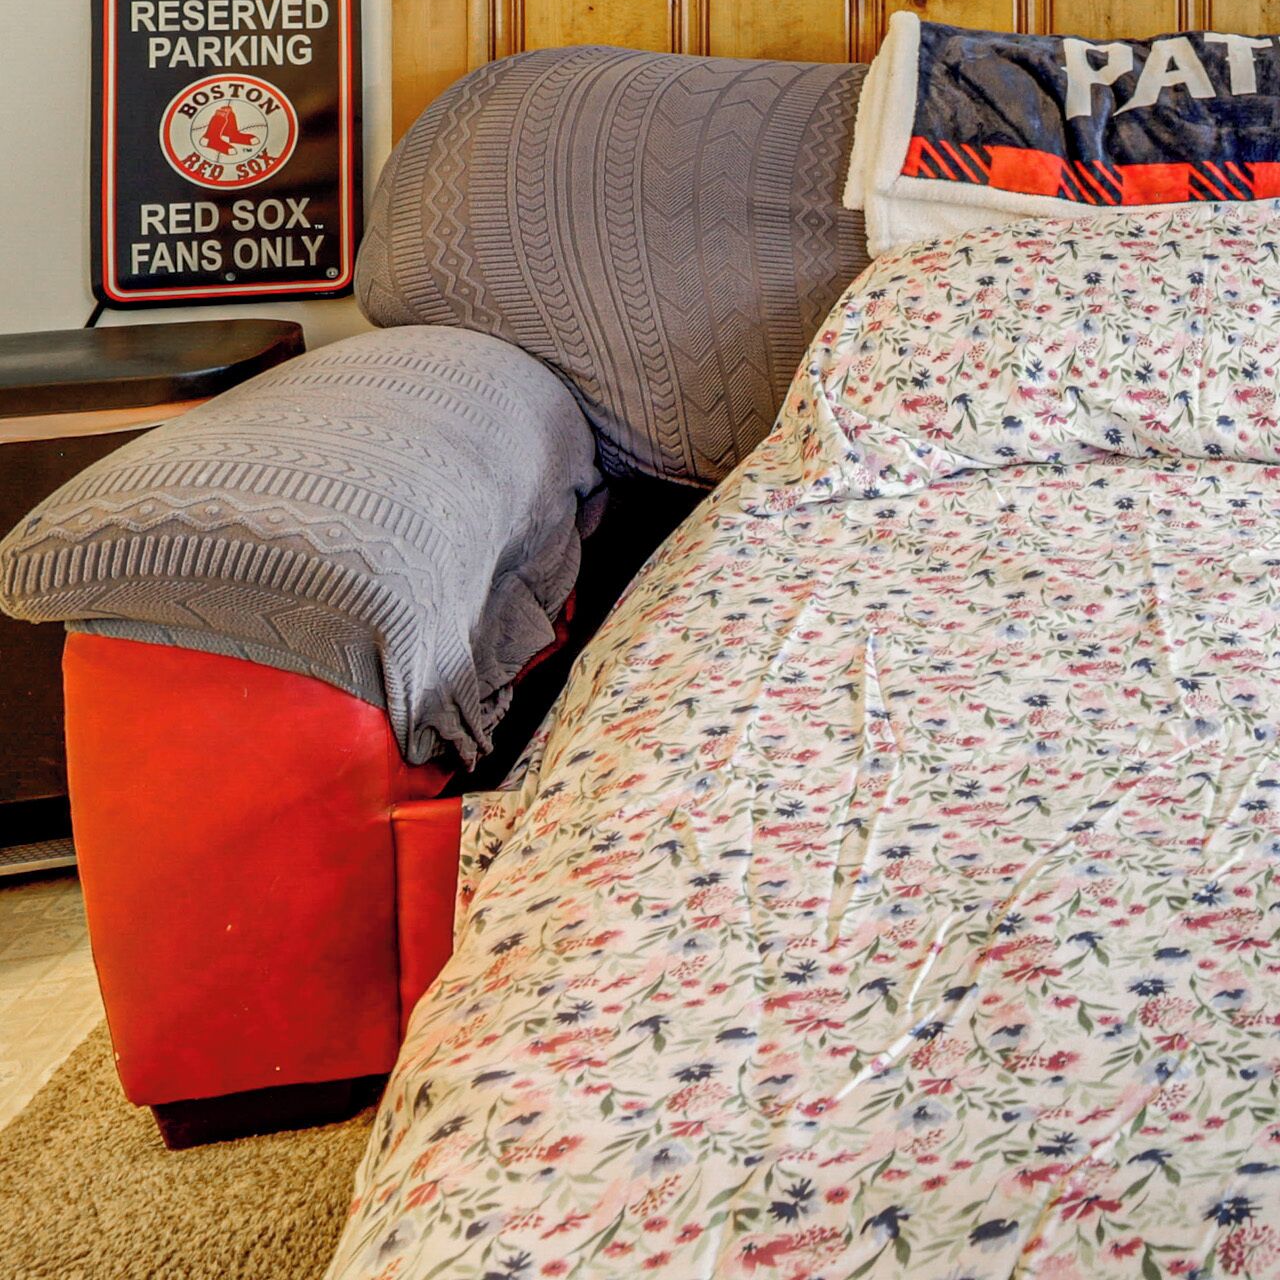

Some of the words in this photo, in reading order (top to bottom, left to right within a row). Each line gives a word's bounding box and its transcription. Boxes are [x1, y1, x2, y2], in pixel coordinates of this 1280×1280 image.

[148, 34, 313, 68] PARKING
[177, 83, 281, 120] BOSTON
[180, 151, 224, 181] RED
[237, 147, 281, 180] SOX
[140, 201, 220, 235] RED
[231, 197, 312, 231] SOX
[131, 239, 223, 274] FANS
[233, 234, 325, 270] ONLY
